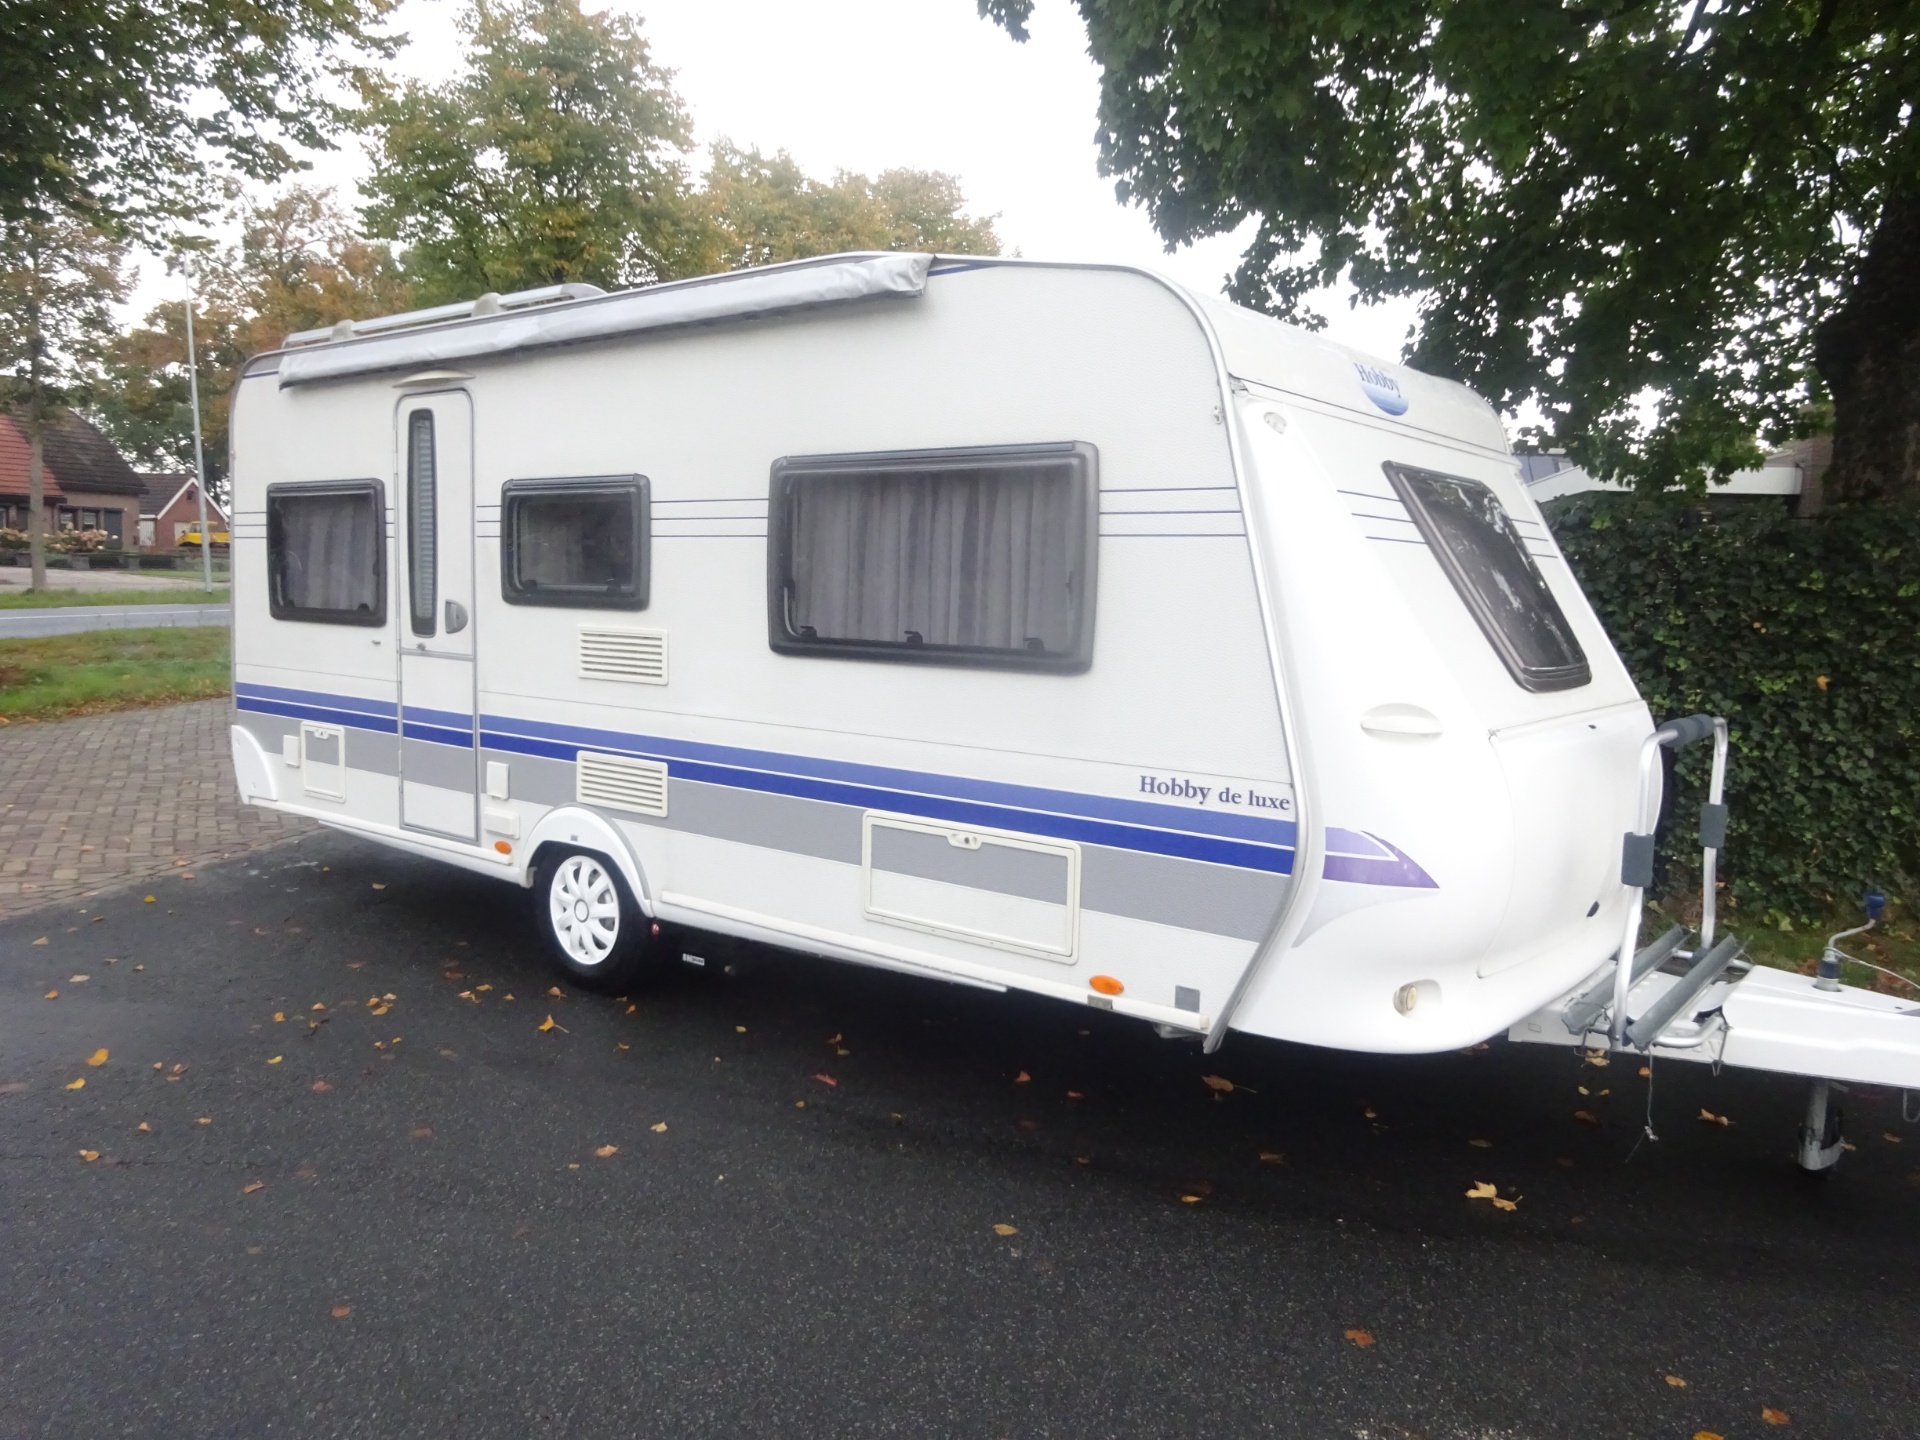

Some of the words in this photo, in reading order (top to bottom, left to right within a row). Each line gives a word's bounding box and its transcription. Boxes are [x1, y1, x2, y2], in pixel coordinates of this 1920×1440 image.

[1353, 362, 1401, 398] Hobby
[1139, 775, 1212, 805] Hobby
[1218, 787, 1242, 804] de
[1248, 790, 1290, 810] luxe
